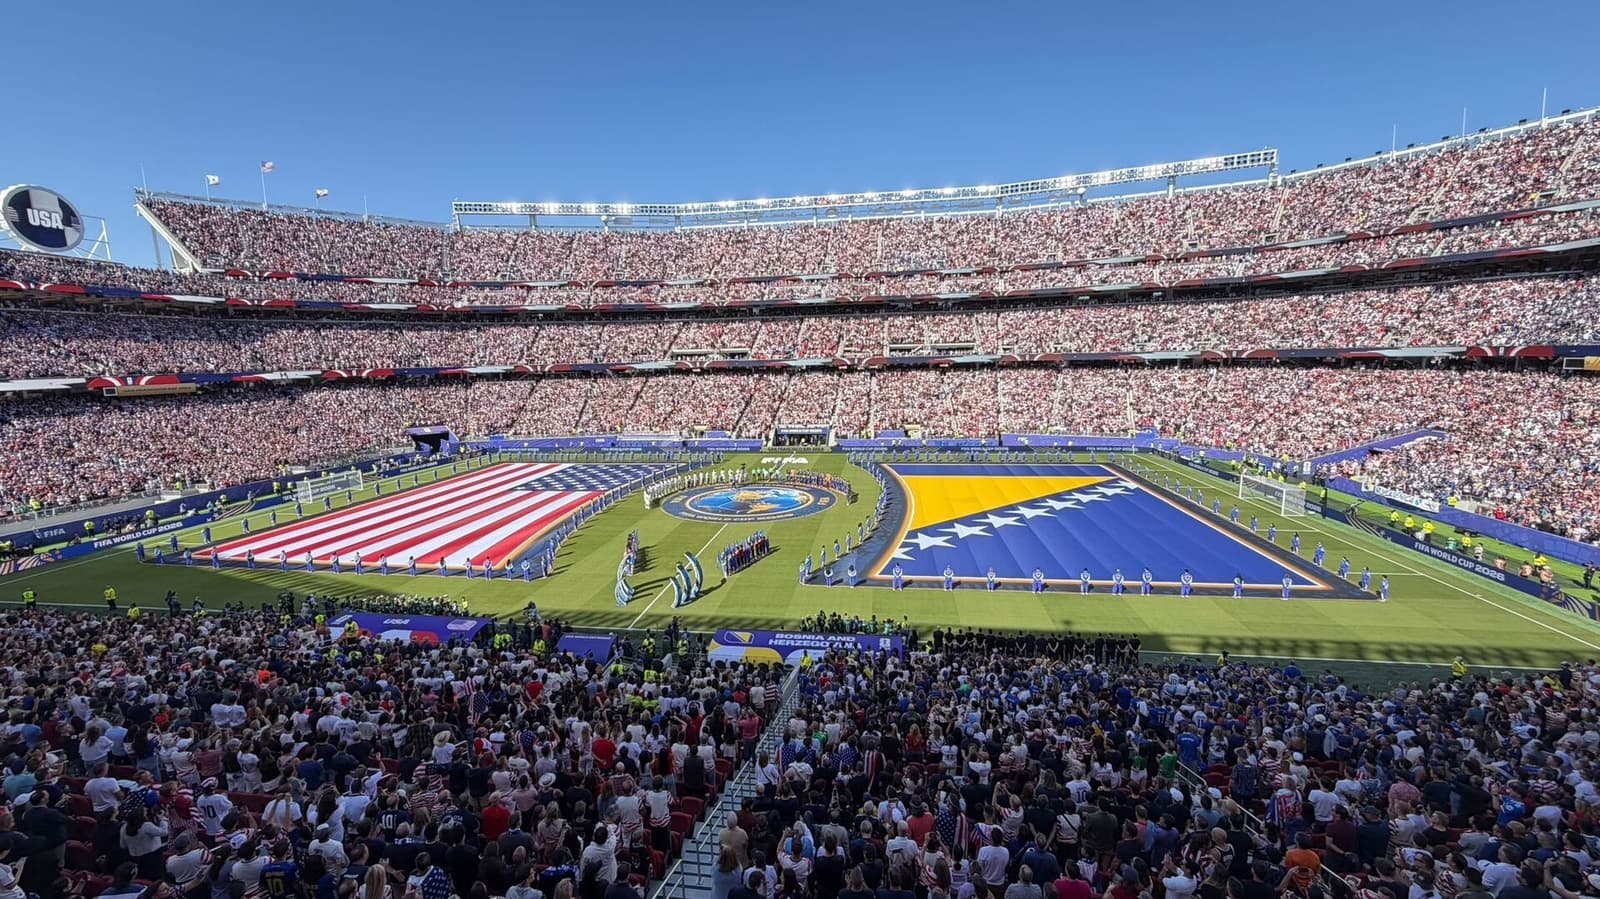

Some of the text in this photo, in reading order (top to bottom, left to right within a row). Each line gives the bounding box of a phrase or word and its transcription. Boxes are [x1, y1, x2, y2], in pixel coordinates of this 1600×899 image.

[26, 207, 65, 230] USA
[43, 528, 66, 538] FIFA
[93, 521, 183, 549] FIFA WORLD CUP 2026
[1414, 542, 1505, 581] FIFA WORLD CUP 2026
